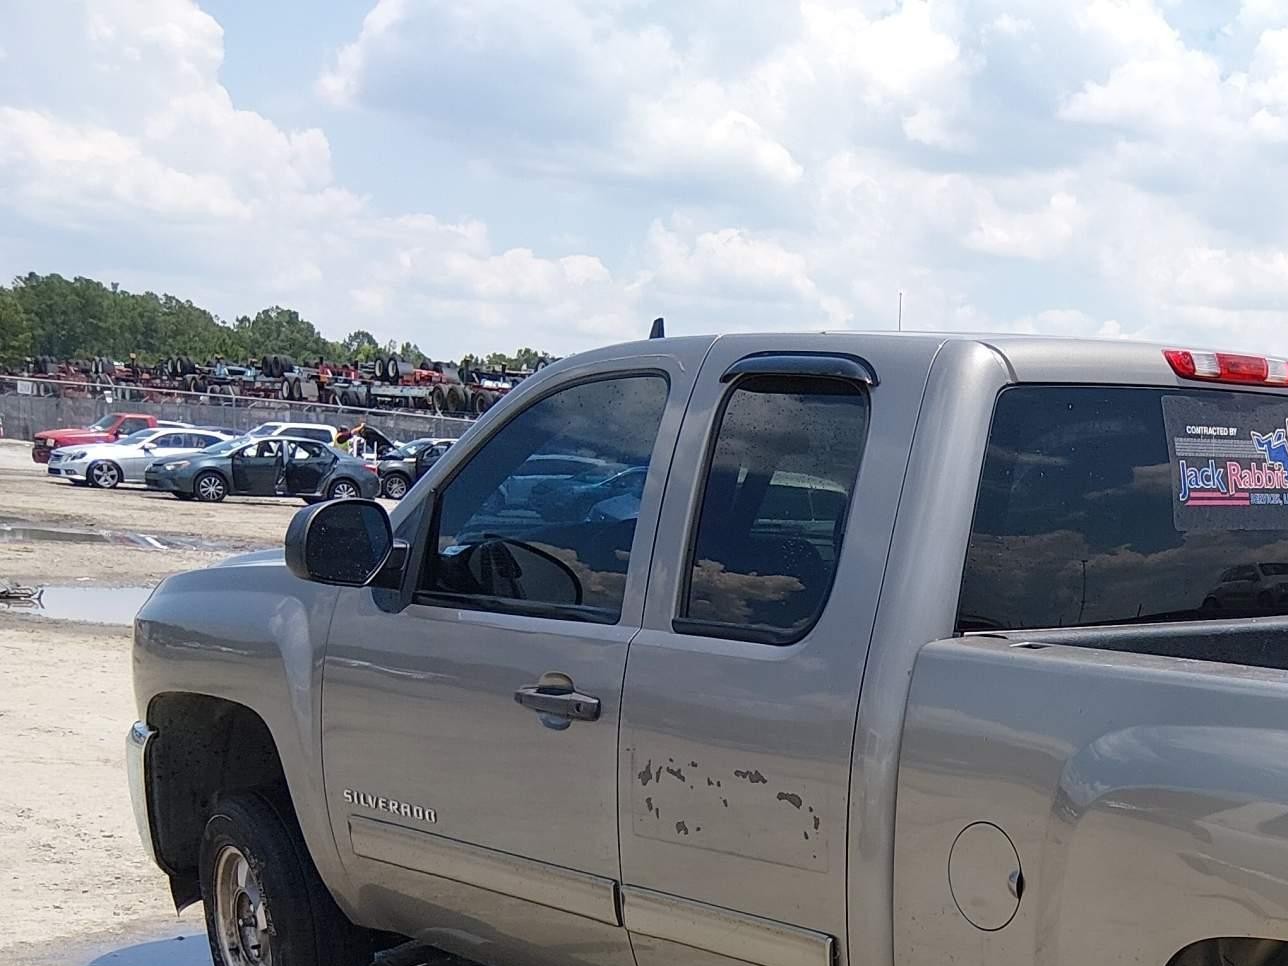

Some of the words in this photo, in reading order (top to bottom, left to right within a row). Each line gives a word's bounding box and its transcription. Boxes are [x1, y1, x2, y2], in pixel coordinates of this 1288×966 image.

[1186, 425, 1228, 436] CONTRACTED
[1229, 427, 1237, 436] BY
[1179, 460, 1227, 501] Jack
[1226, 461, 1288, 495] Rabbit
[343, 789, 437, 824] SILVERADO
